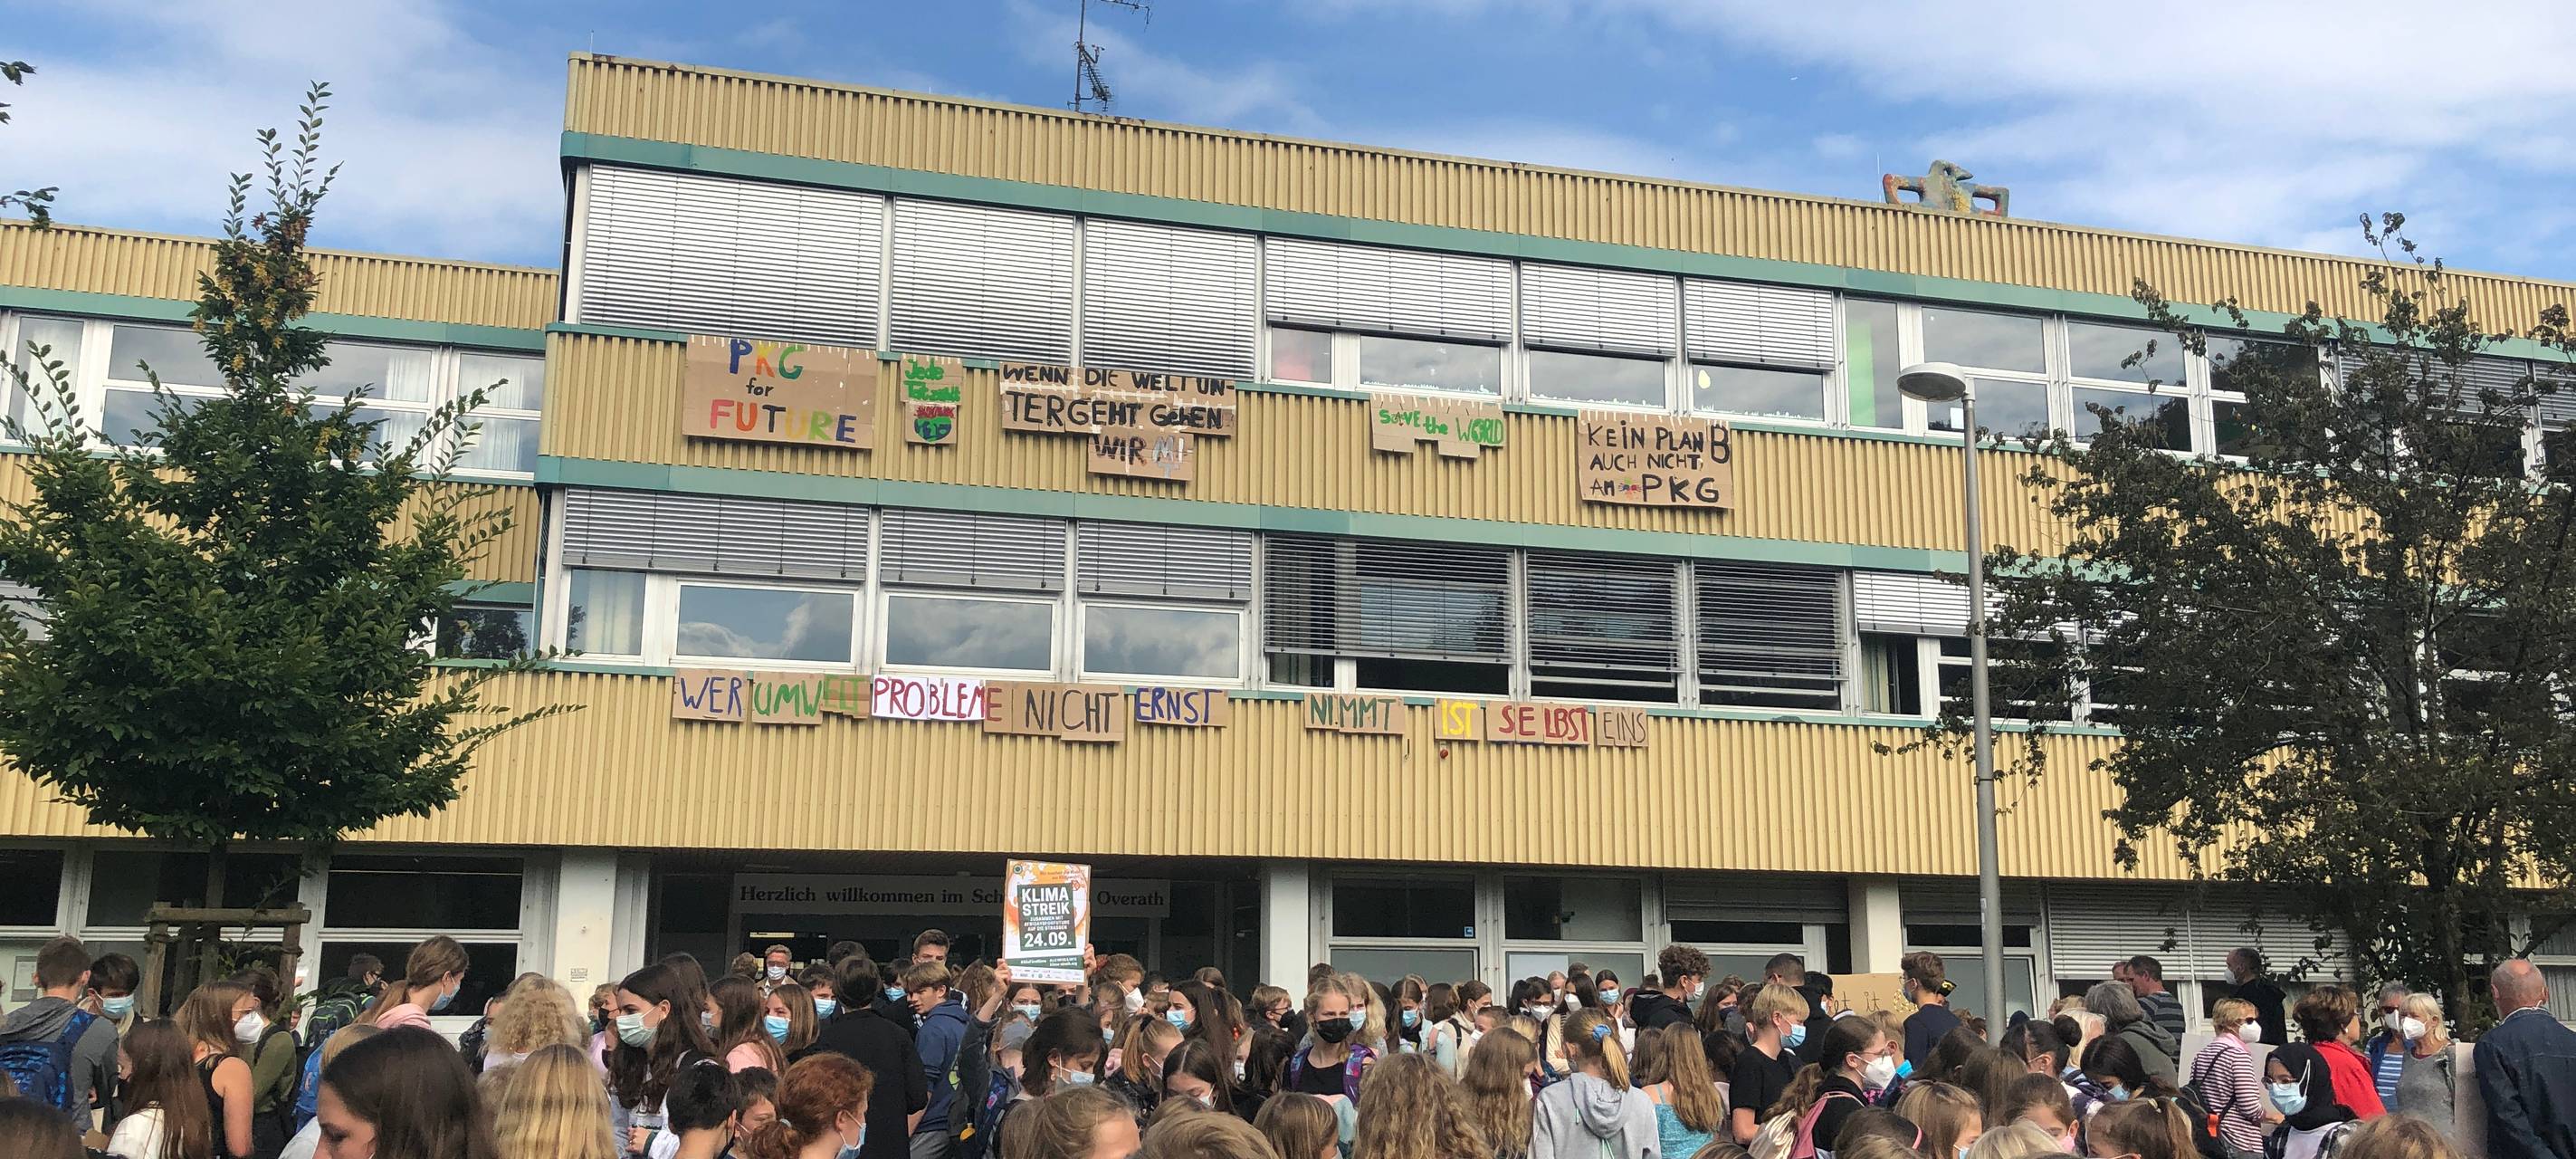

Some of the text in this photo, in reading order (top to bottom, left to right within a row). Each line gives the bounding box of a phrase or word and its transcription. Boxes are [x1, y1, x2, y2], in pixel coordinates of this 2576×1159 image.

[729, 339, 804, 379] PKG
[746, 378, 774, 397] for
[1004, 364, 1235, 396] WENN DIE WELT UN-
[710, 399, 857, 443] FUTURE
[1423, 416, 1448, 435] the
[1455, 417, 1503, 445] WORLD
[1092, 433, 1147, 465] WIR
[1655, 427, 1704, 453] PLAN
[1711, 424, 1731, 464] B
[1589, 454, 1637, 472] AUCH
[1589, 474, 1720, 503] AM PKG
[681, 676, 742, 717] WER
[1026, 688, 1119, 733] NICHT
[1135, 687, 1223, 723] ERNST
[1441, 700, 1478, 739] IST
[1603, 711, 1646, 743] EINS
[739, 886, 816, 903] Herzlich
[826, 886, 935, 904] willkommen
[941, 889, 963, 904] im
[1097, 890, 1164, 905] Overath
[1022, 886, 1069, 903] KLIMA
[1022, 902, 1070, 916] STREIK
[1024, 932, 1072, 948] 24.09.
[1833, 991, 1881, 1013] et it
